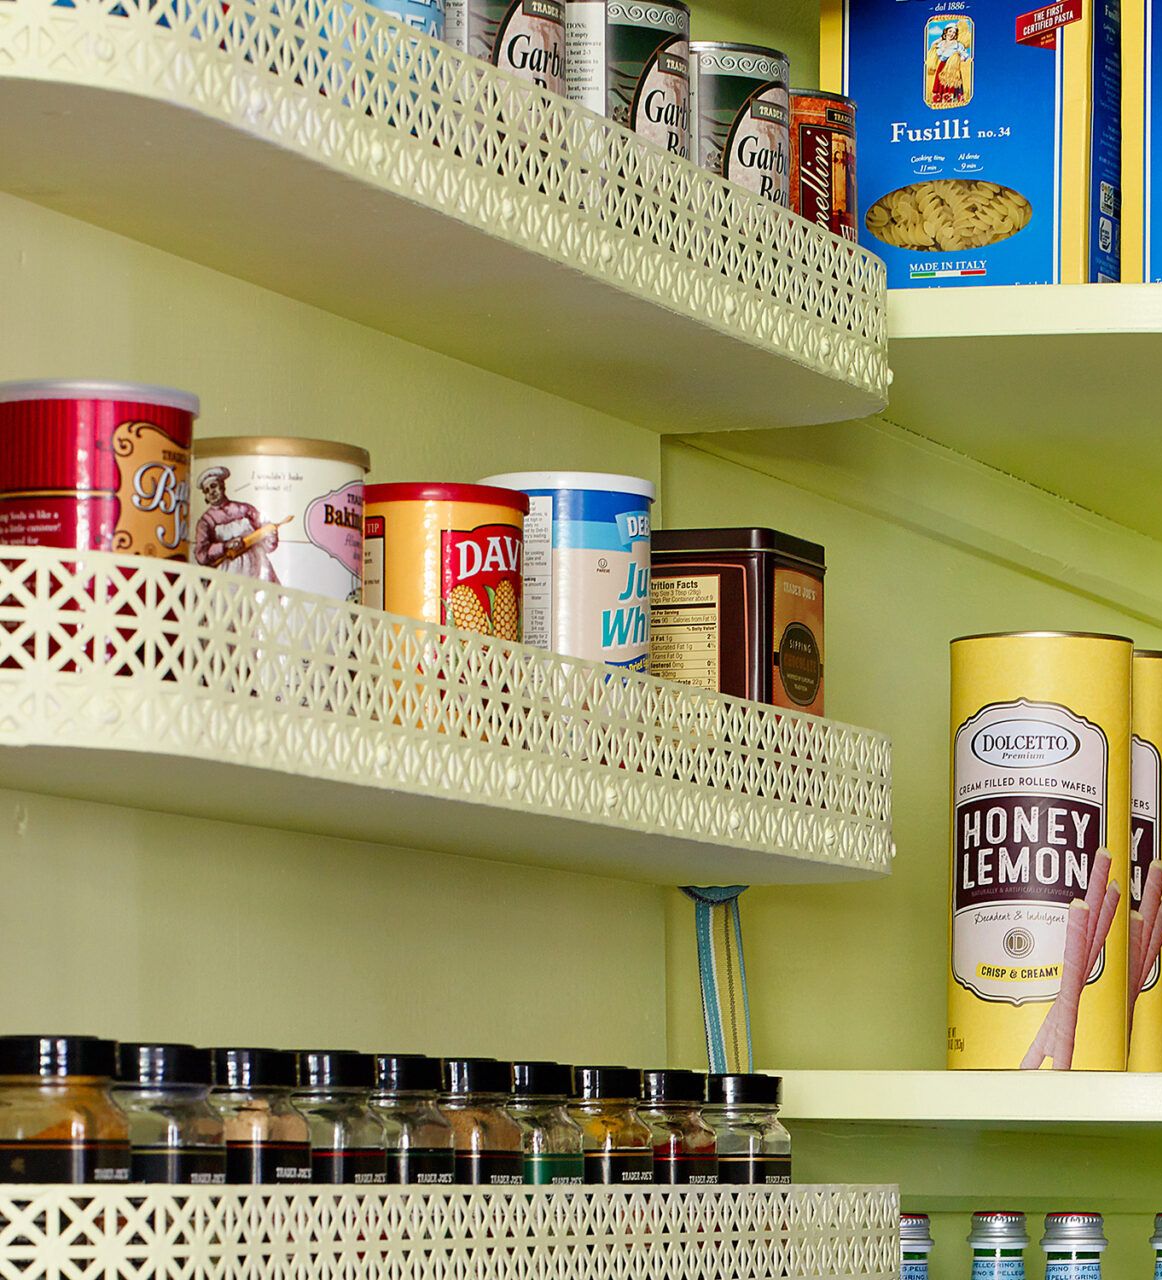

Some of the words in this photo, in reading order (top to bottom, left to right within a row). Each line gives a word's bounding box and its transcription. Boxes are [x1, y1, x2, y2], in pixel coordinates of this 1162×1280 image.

[532, 2, 559, 17] TRADER
[947, 2, 964, 11] 1886
[1033, 11, 1045, 21] THE
[1045, 5, 1063, 19] FIRST
[1023, 18, 1053, 36] CERTIFIED
[1054, 11, 1074, 28] PASTA
[891, 119, 970, 143] Fusilli
[911, 154, 932, 163] Cooking
[932, 154, 945, 162] time
[910, 262, 938, 271] MADE
[940, 261, 953, 270] IN
[955, 259, 987, 270] ITALY
[367, 523, 378, 533] TIP
[651, 581, 674, 590] trition
[677, 580, 698, 588] Facts
[789, 639, 811, 653] SIPPING
[983, 734, 1069, 752] DOLCETTO
[1002, 752, 1045, 760] Premium
[959, 781, 982, 796] CREAM
[984, 777, 1015, 788] FILLED
[1019, 777, 1057, 787] ROLLED
[1061, 780, 1097, 796] WAFERS
[964, 806, 1091, 850] HONEY
[962, 846, 1088, 890] LEMON
[974, 912, 1011, 924] Decadent
[1016, 911, 1023, 919] &
[1026, 911, 1065, 926] Indulgent
[981, 966, 1007, 978] CRISP
[1009, 969, 1018, 979] &
[1020, 966, 1059, 979] CREAMY
[276, 1167, 298, 1179] TRADER
[298, 1168, 312, 1179] JOE'S
[417, 1173, 437, 1183] TRADER
[438, 1173, 453, 1183] JOE'S
[622, 1171, 640, 1181] TRADER
[640, 1171, 653, 1181] JOE'S
